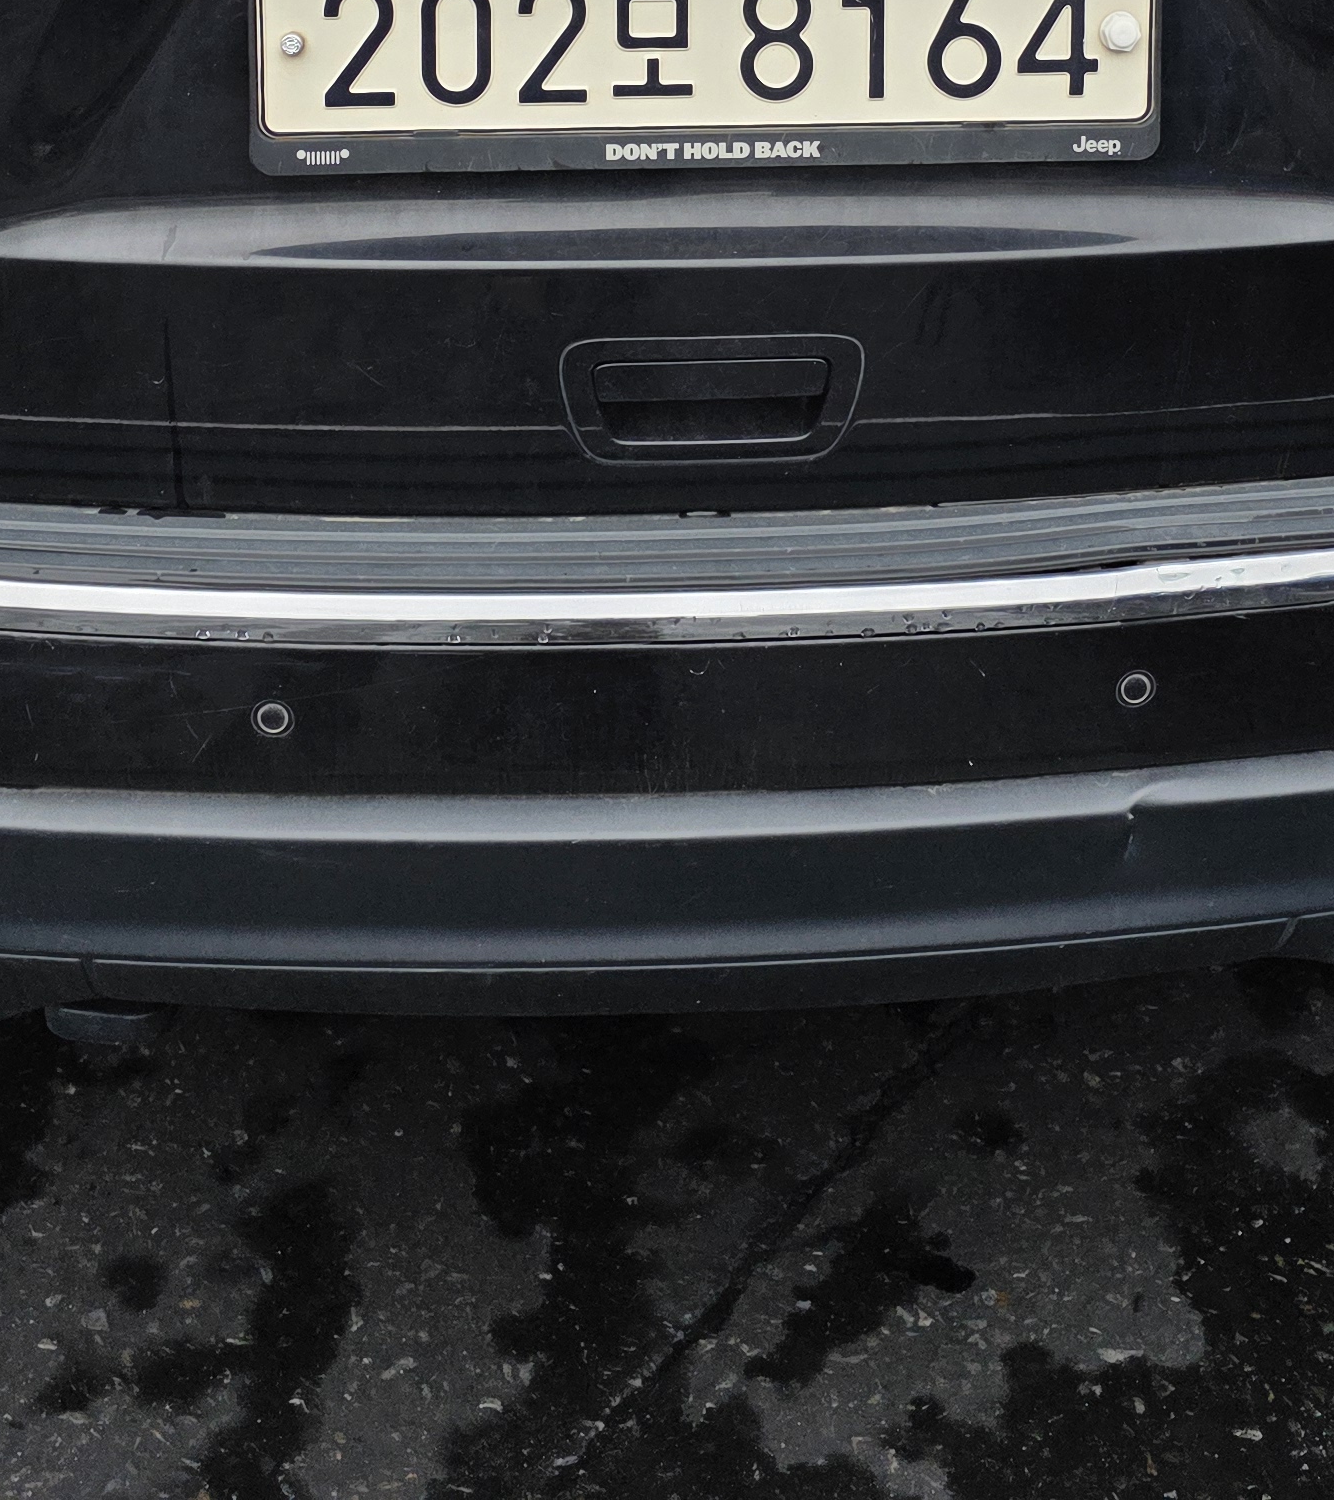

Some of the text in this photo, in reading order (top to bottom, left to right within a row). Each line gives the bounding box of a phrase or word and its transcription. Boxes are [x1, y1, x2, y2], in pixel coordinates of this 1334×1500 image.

[605, 140, 821, 160] DON'T HOLD BACK
[1072, 135, 1122, 156] Jeep
